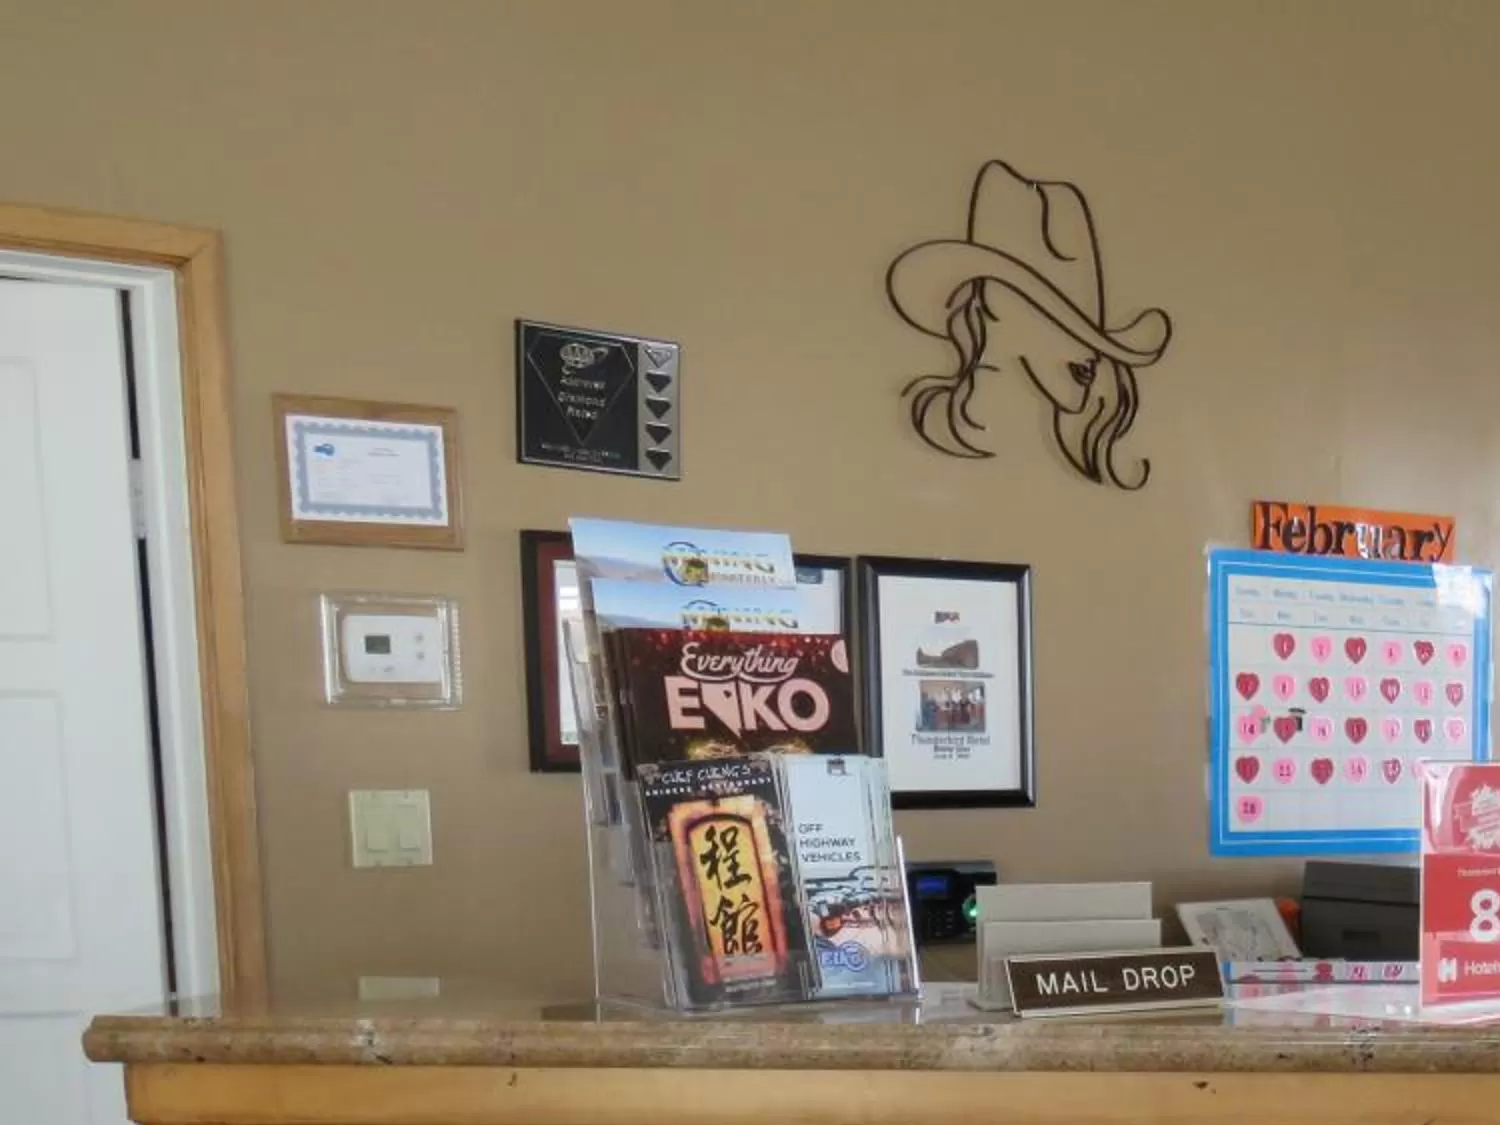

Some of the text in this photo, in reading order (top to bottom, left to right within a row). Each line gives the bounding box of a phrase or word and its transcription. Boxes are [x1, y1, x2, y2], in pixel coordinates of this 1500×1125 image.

[1258, 500, 1455, 563] February
[681, 642, 799, 683] Everything
[799, 823, 824, 835] OFF
[799, 837, 856, 849] HIGHWAY
[801, 851, 862, 863] VEHICLES
[1035, 964, 1196, 996] MAIL DROP
